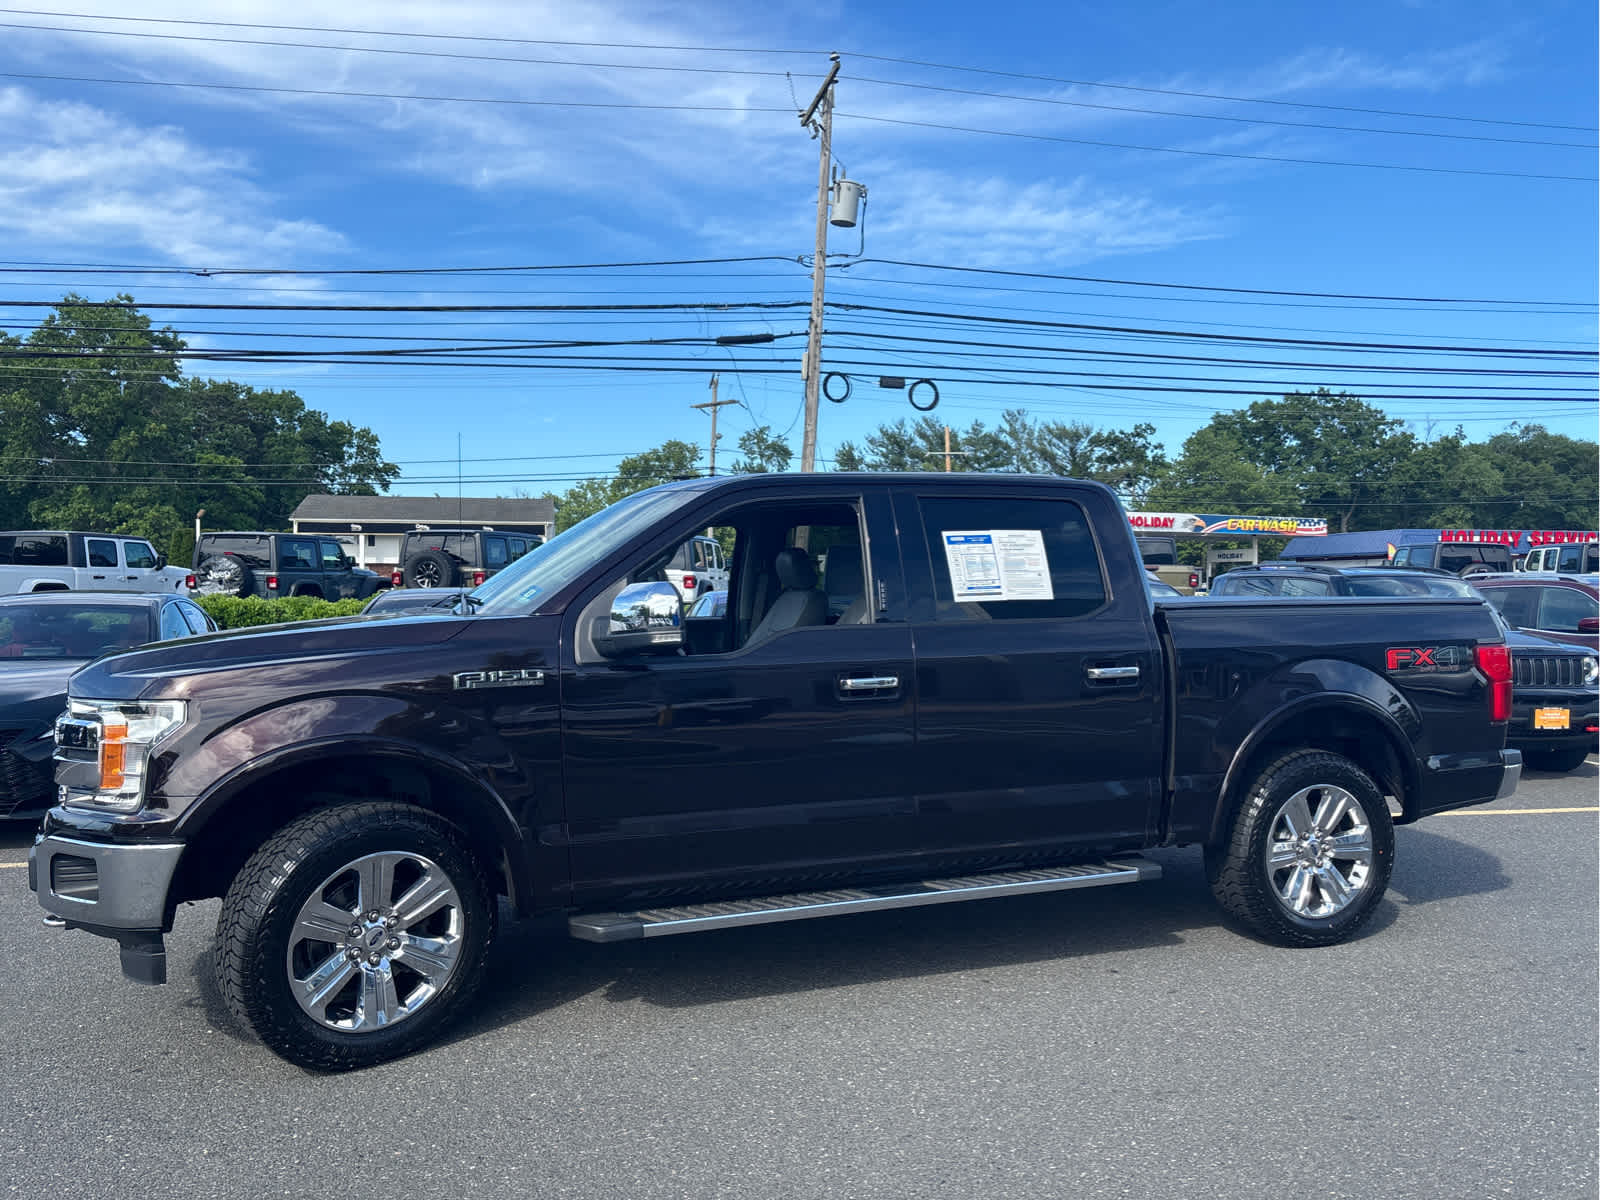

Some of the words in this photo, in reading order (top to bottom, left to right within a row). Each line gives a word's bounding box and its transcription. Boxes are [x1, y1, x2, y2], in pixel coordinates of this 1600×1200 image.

[1128, 516, 1175, 528] HOLIDAY
[1227, 519, 1255, 531] CAR
[1259, 520, 1297, 533] WASH
[1386, 646, 1459, 672] FX4
